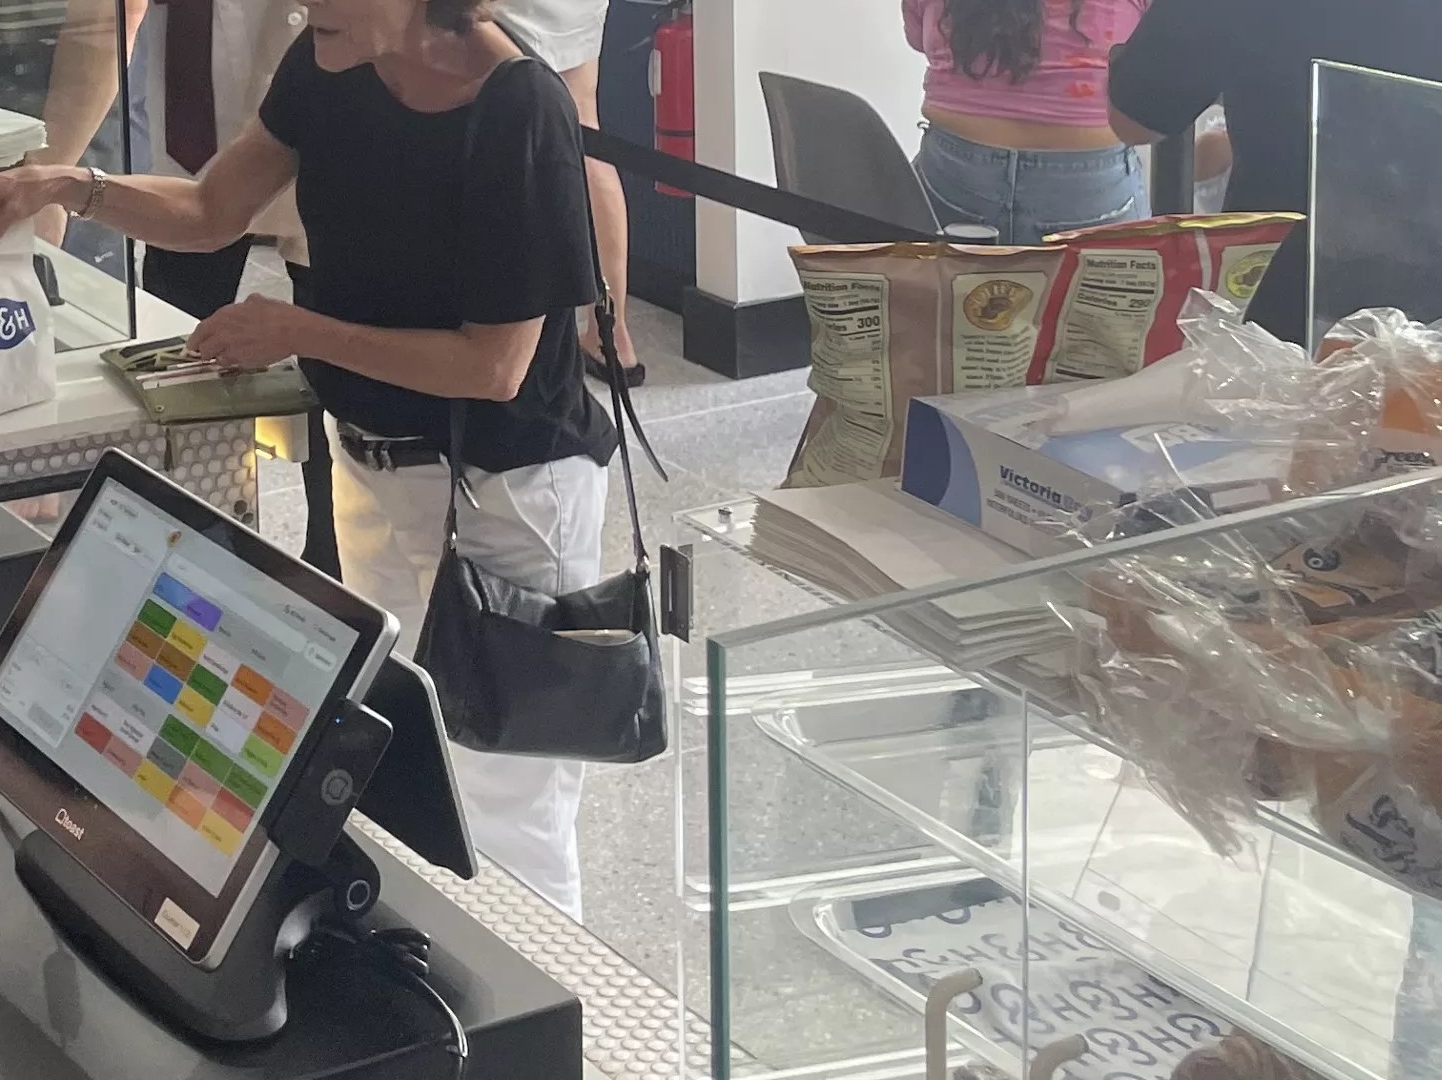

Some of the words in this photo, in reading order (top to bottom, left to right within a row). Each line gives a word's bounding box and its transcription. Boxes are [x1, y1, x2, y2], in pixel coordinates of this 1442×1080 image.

[1129, 260, 1157, 271] Facts
[857, 315, 881, 330] 300
[999, 464, 1062, 504] Victoria
[63, 815, 86, 842] toast
